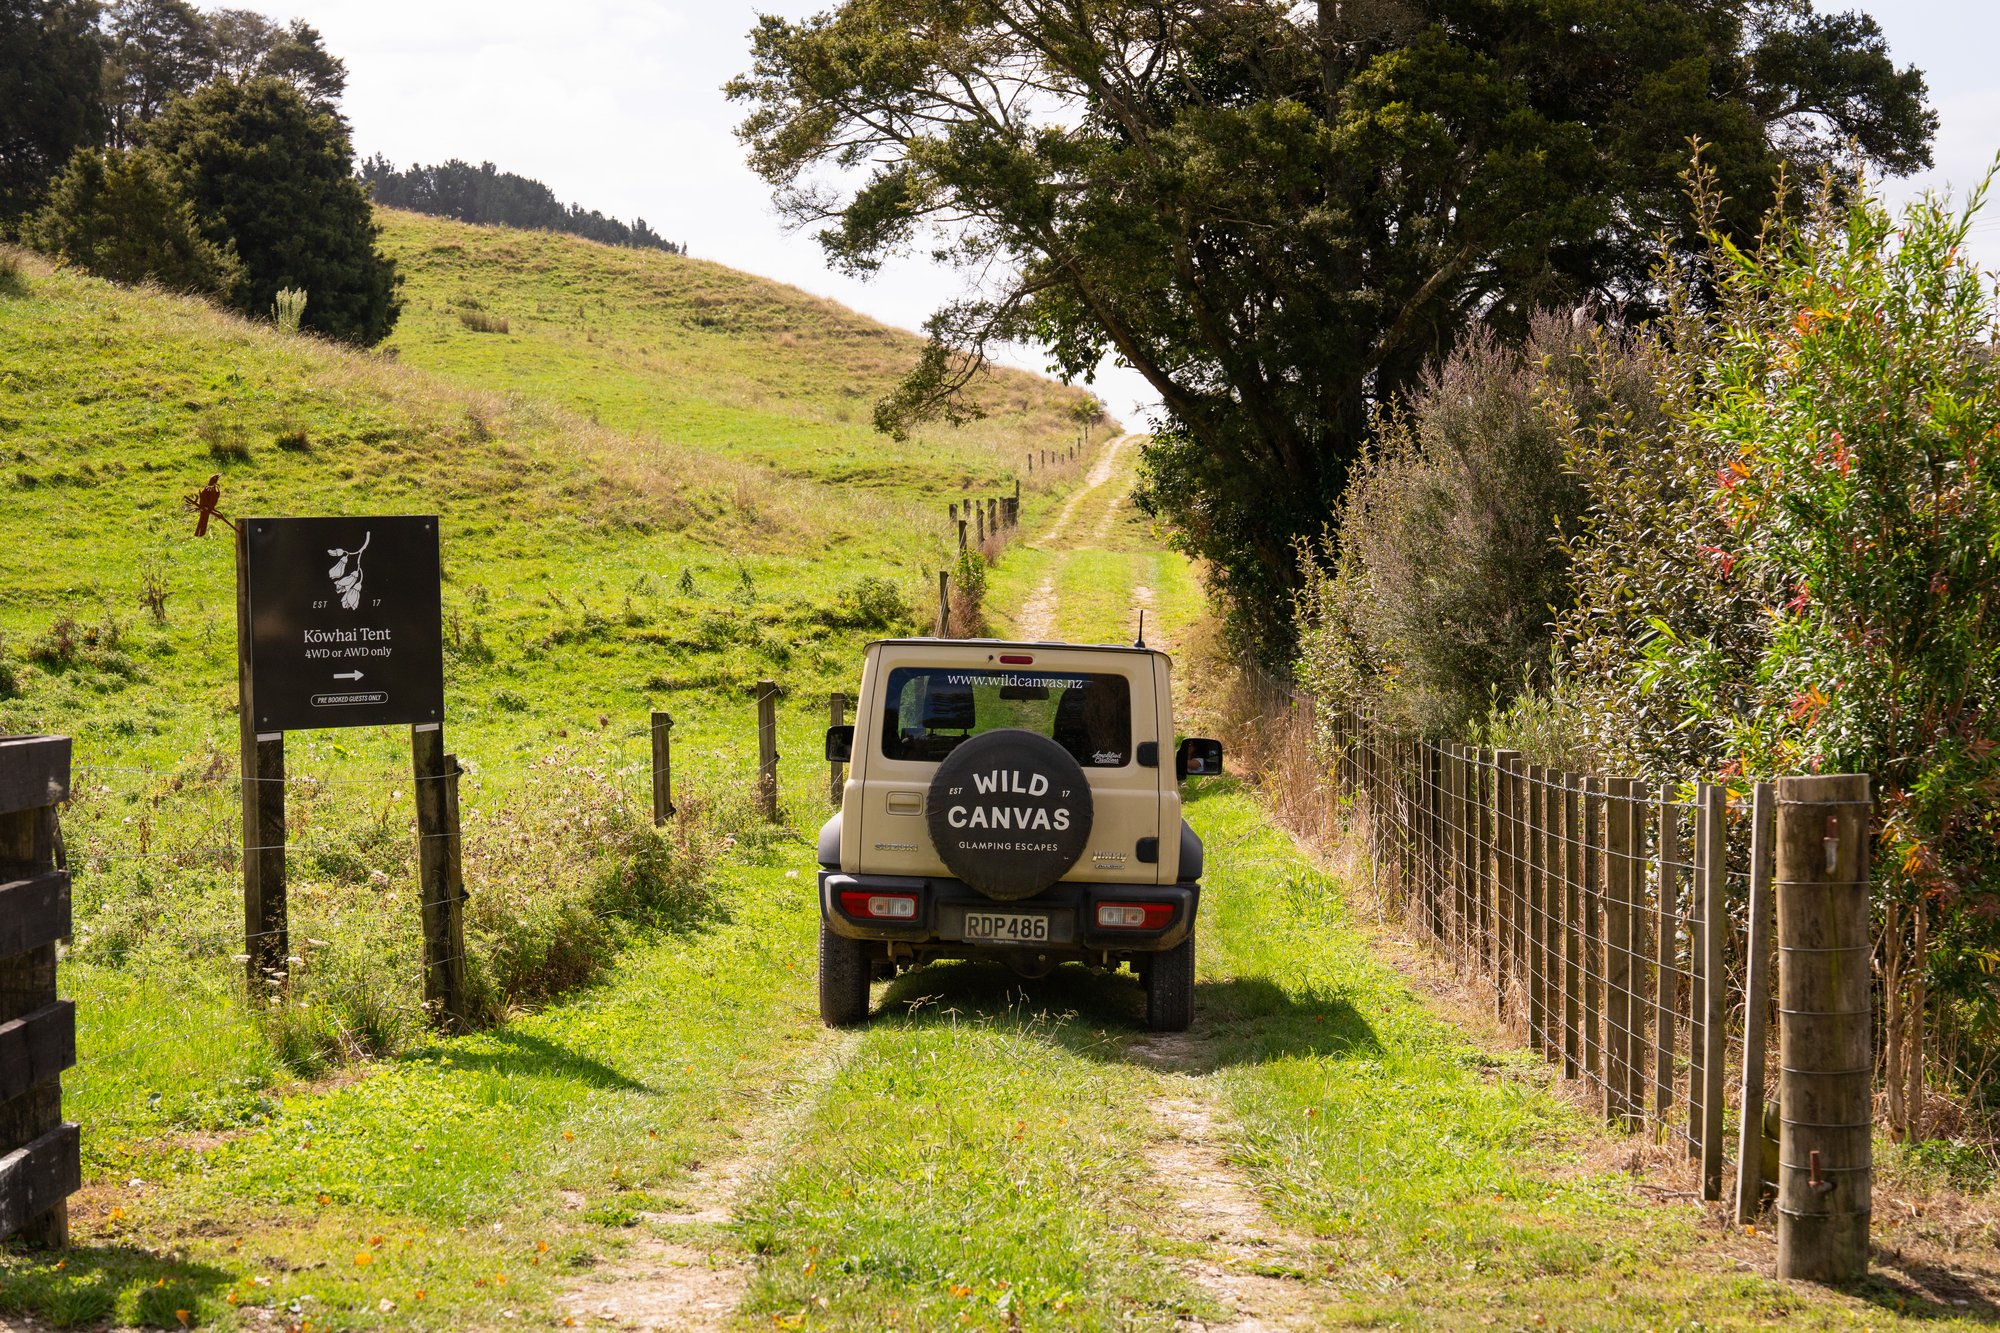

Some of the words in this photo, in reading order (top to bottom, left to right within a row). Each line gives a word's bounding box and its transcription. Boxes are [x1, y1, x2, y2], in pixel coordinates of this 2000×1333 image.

[313, 601, 328, 609] EST
[372, 599, 381, 607] 17
[303, 627, 358, 643] Kōwhai
[359, 627, 392, 641] Tent
[304, 648, 330, 659] 4WD
[331, 649, 343, 658] or
[343, 647, 369, 657] AWD
[370, 646, 392, 658] only
[947, 674, 1083, 689] www.wildcanvas.nz
[317, 696, 327, 704] PRE
[327, 695, 348, 703] BOOKED
[368, 694, 381, 702] ONLY
[948, 787, 963, 795] EST
[972, 769, 1049, 797] WILD
[1061, 790, 1071, 798] 17
[947, 805, 1070, 831] CANVAS
[958, 841, 1012, 850] GLAMPING
[1015, 843, 1058, 852] ESCAPES
[967, 916, 1046, 939] RDP486
